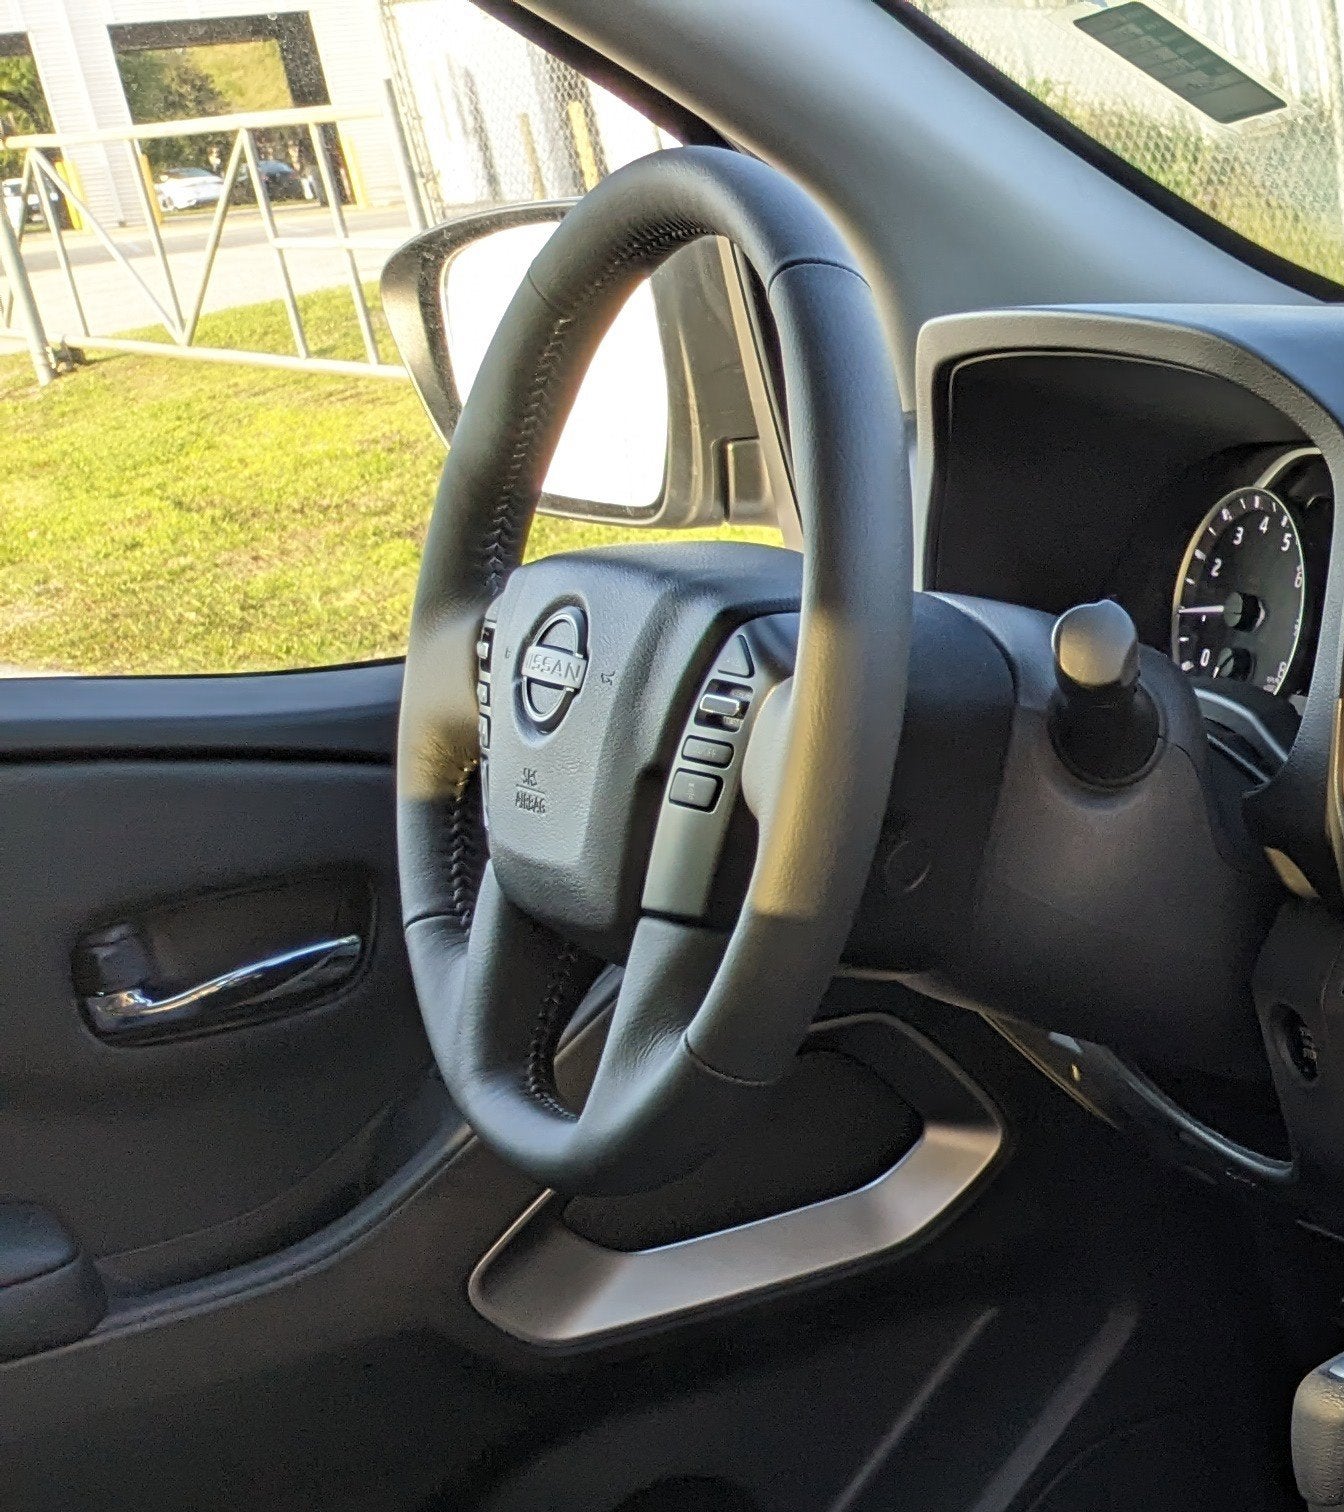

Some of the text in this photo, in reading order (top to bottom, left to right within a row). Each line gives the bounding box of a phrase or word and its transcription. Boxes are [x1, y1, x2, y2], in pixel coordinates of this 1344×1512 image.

[1259, 516, 1270, 534] 4
[1233, 526, 1244, 545] 3
[1281, 532, 1292, 551] 5
[1211, 558, 1222, 577] 2
[1200, 648, 1211, 667] 0
